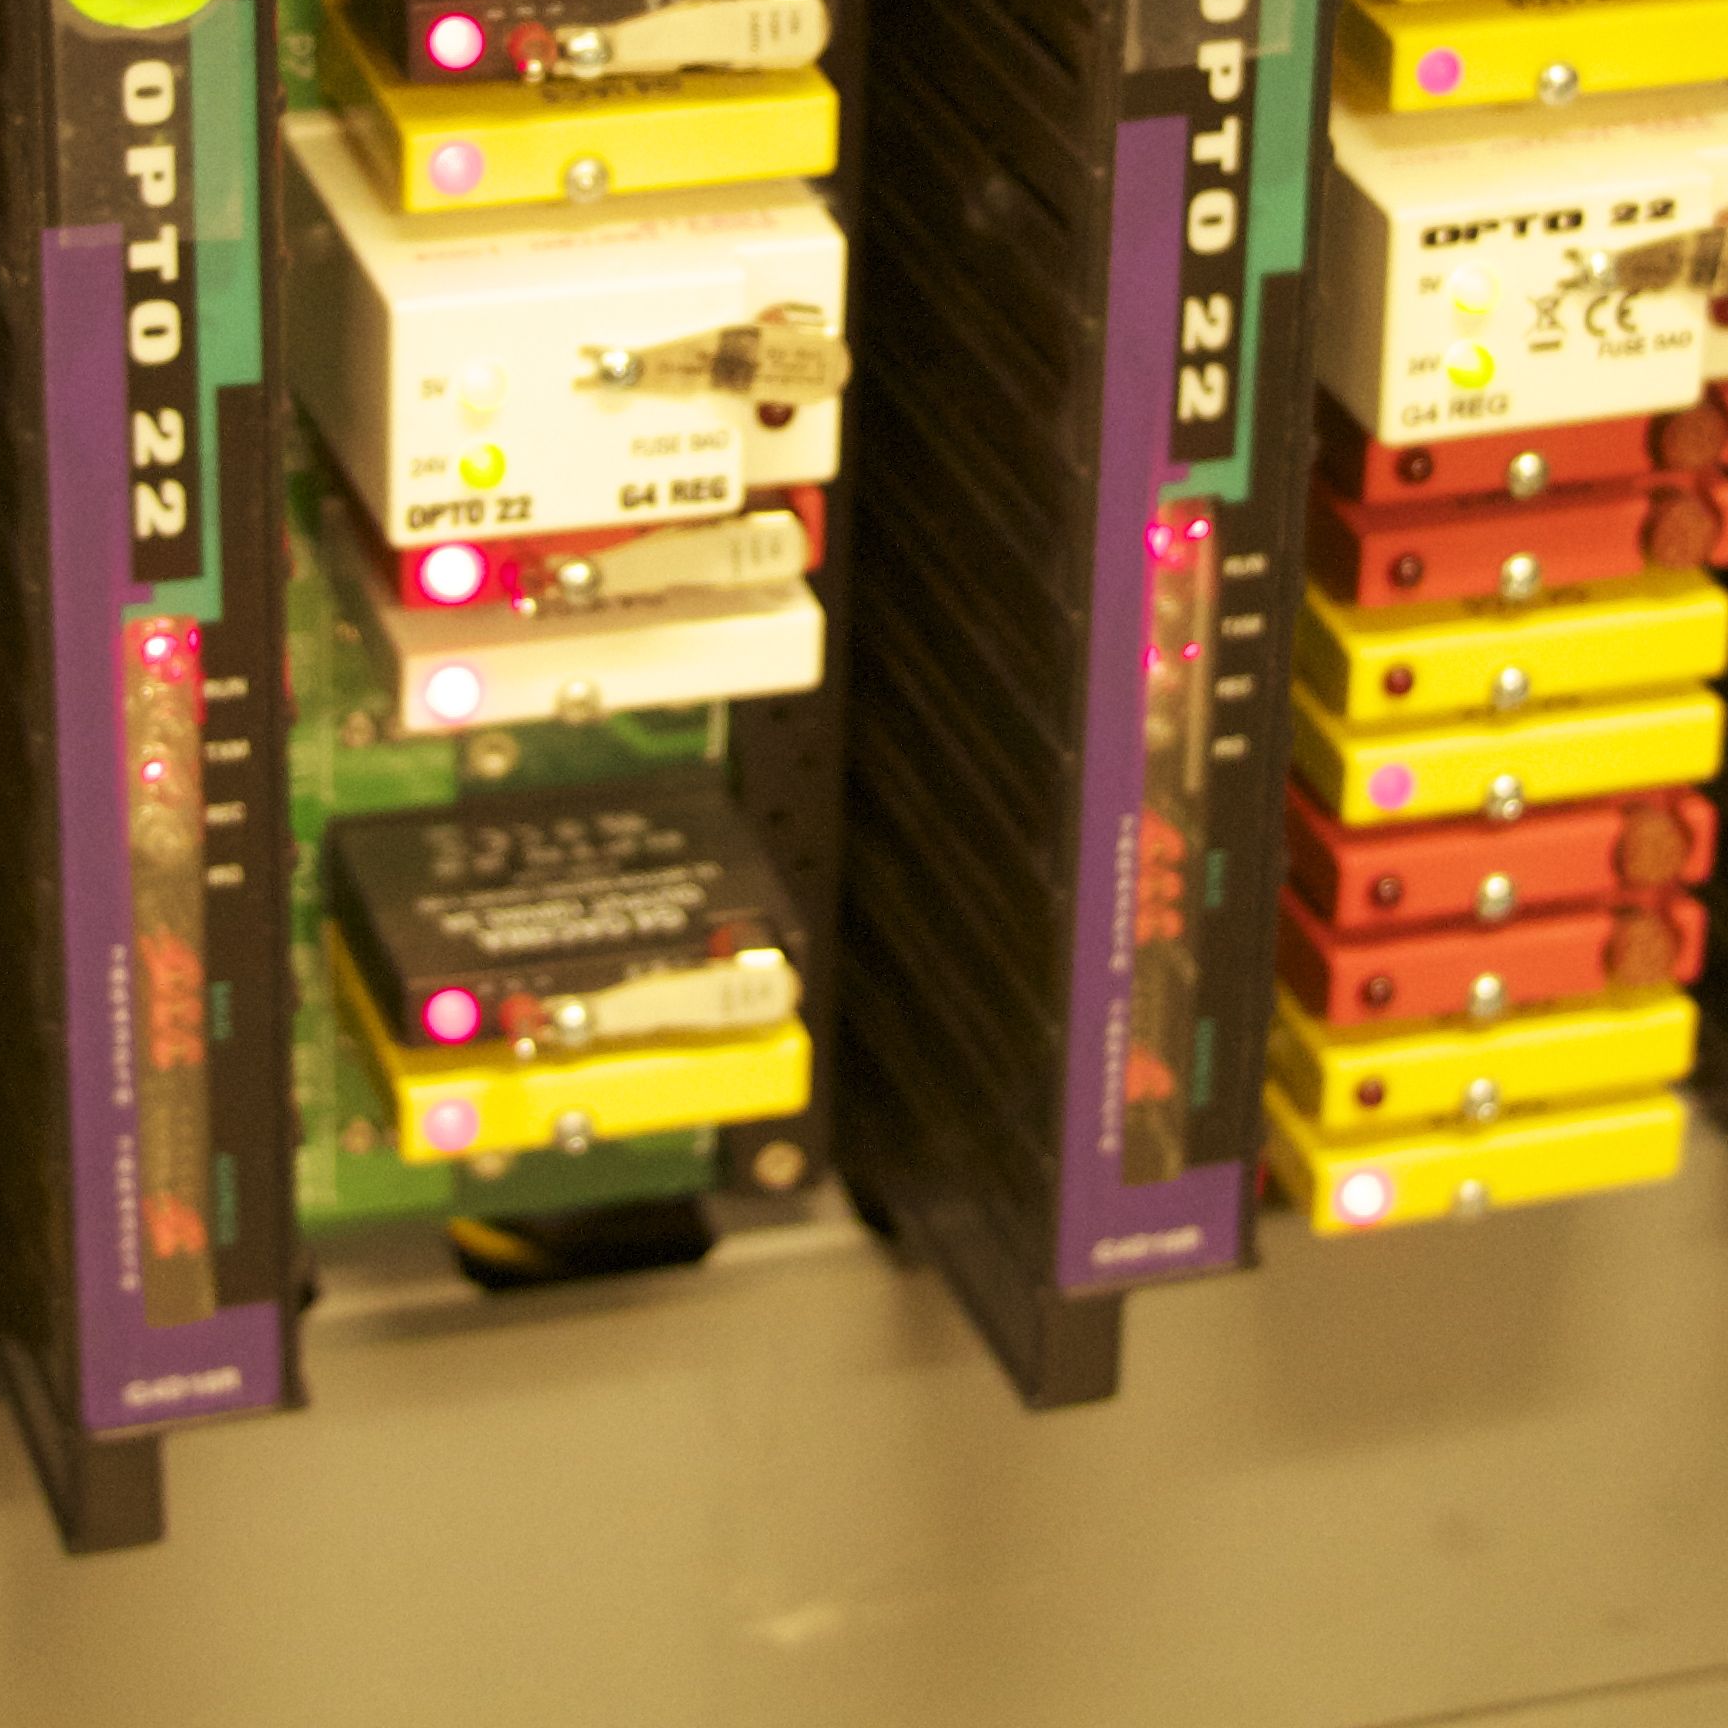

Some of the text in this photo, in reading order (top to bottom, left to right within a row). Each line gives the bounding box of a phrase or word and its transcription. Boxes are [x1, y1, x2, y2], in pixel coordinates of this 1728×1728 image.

[1420, 198, 1676, 249] OPTO 22
[121, 59, 186, 540] OPTO 22
[1176, 294, 1235, 422] 22
[494, 494, 533, 522] 22
[668, 476, 726, 505] REG
